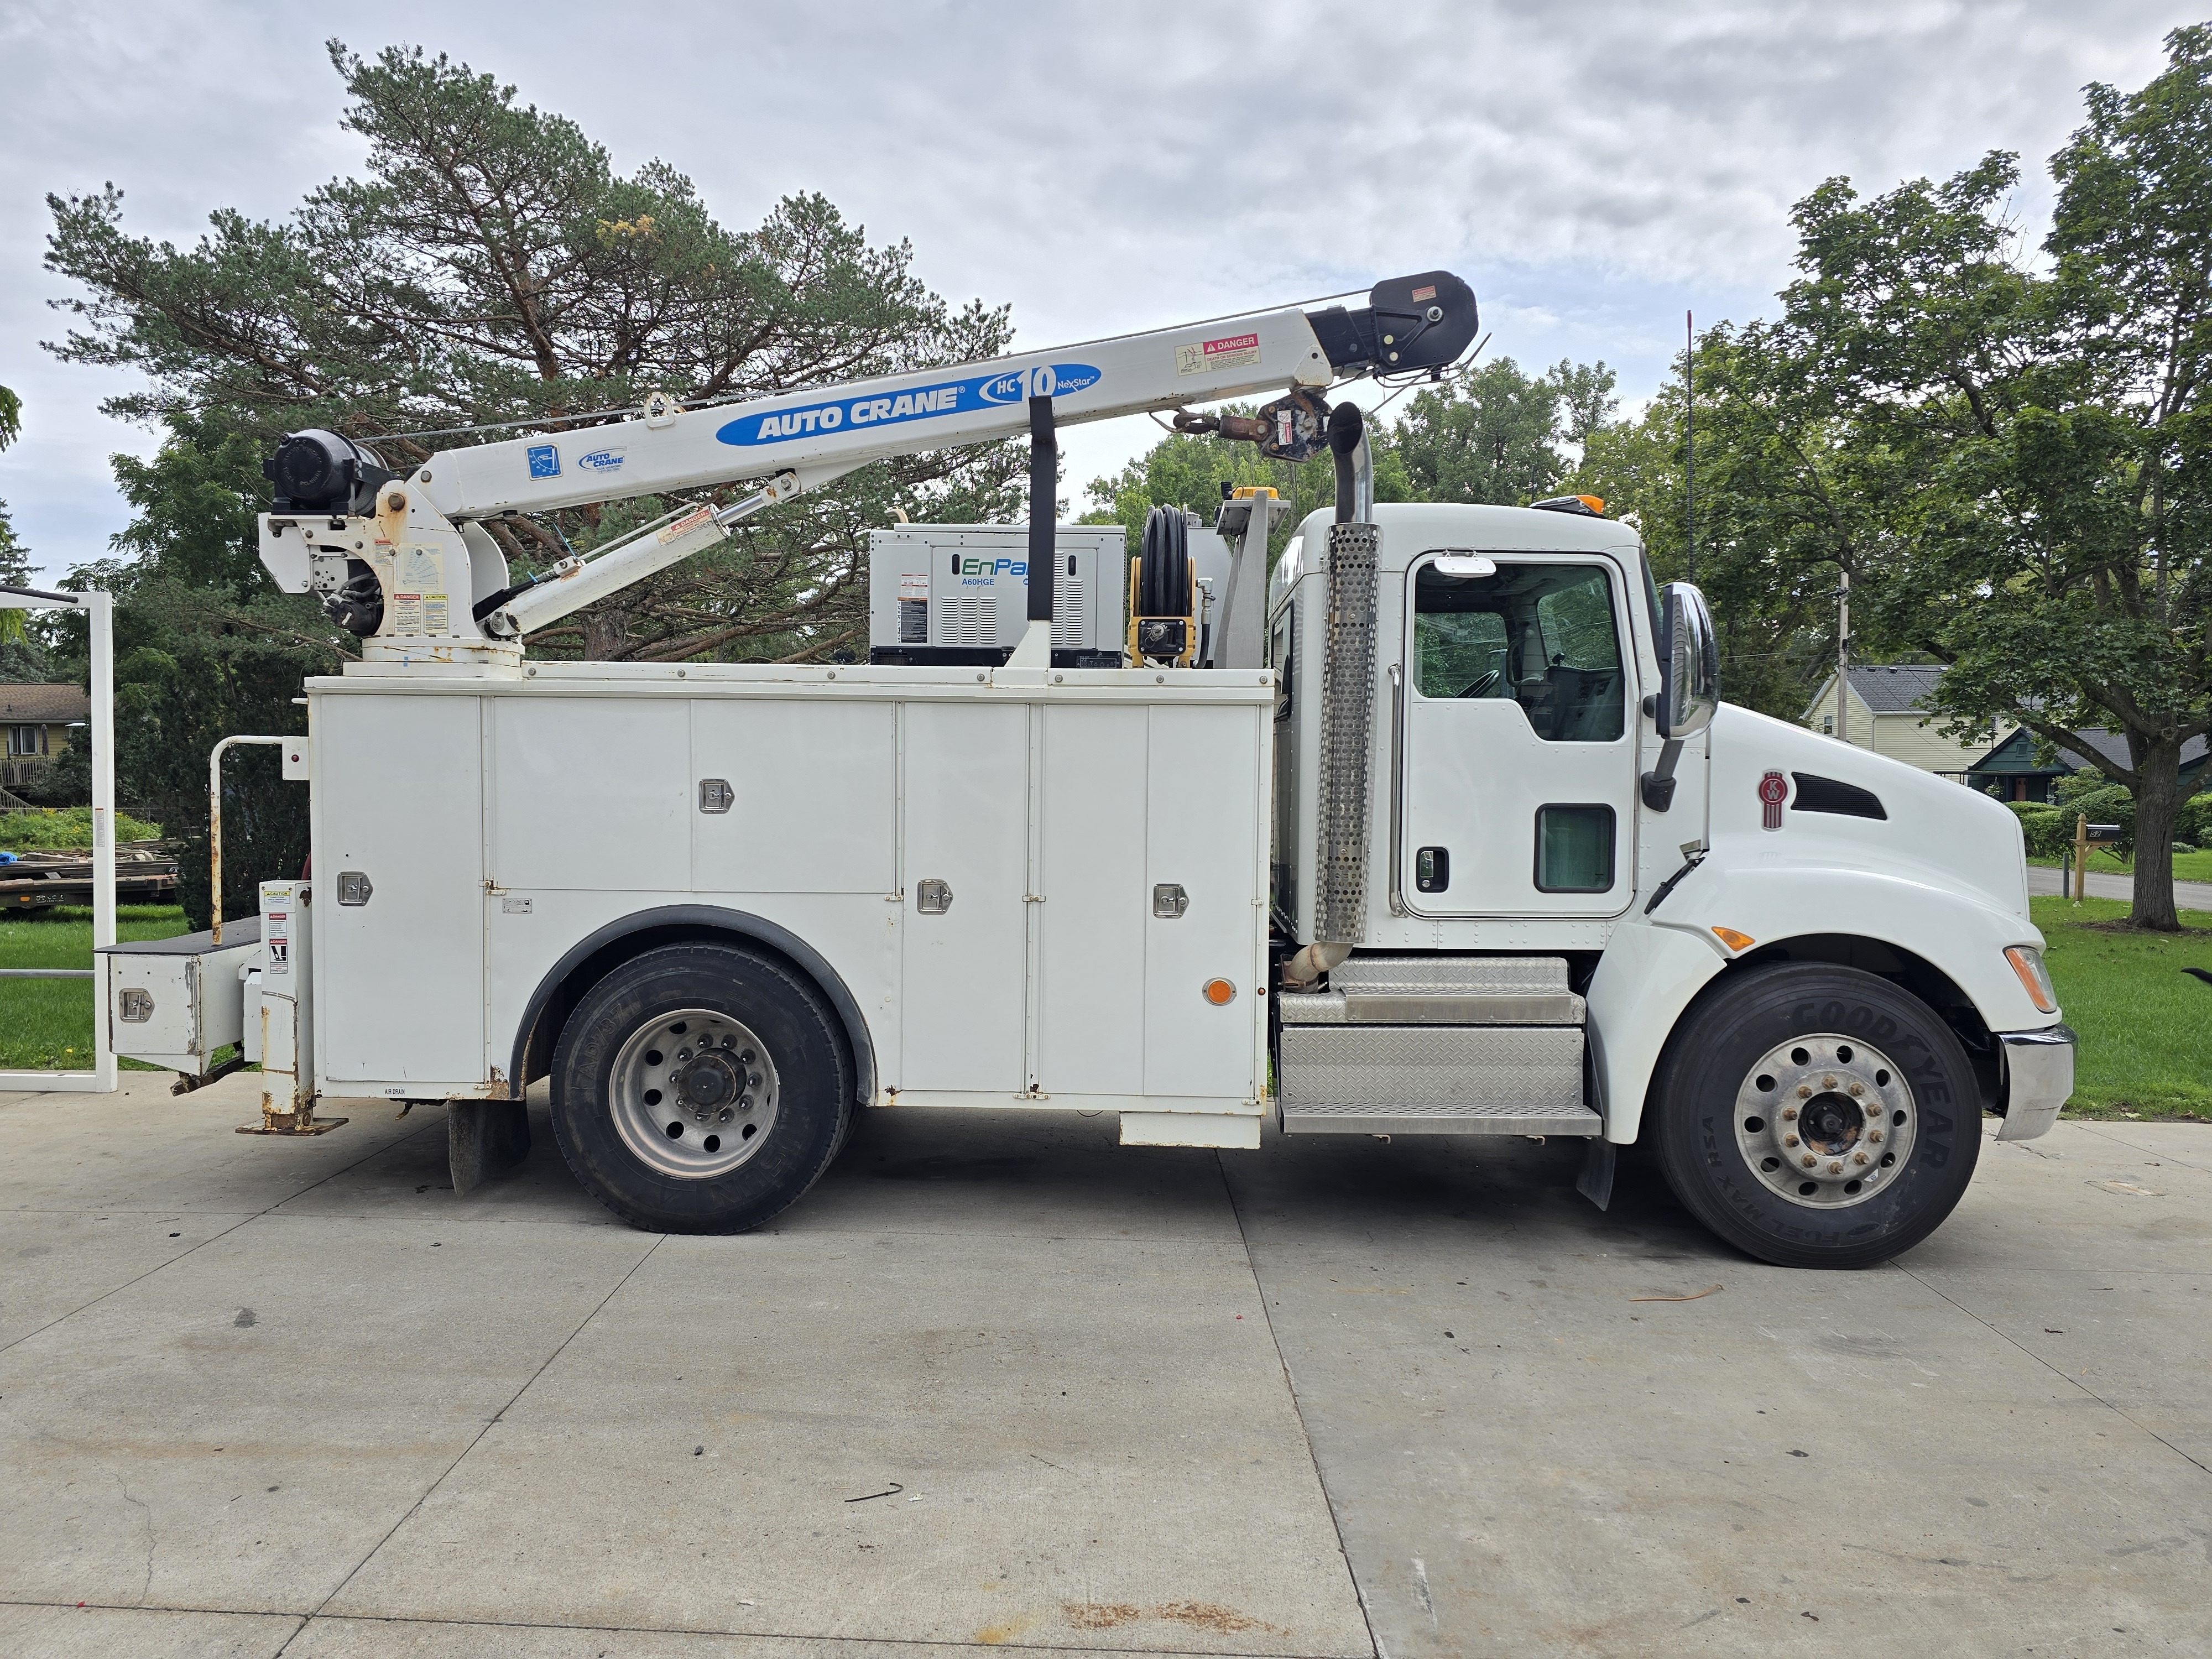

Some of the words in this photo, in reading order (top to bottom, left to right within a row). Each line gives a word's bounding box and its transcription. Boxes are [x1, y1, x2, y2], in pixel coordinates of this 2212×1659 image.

[1218, 337, 1255, 349] DANGER
[997, 379, 1015, 394] HC
[757, 406, 842, 440] AUTO
[586, 453, 610, 462] AUTO
[593, 457, 624, 467] CRANE
[681, 512, 706, 526] DANGER
[962, 559, 1029, 575] EnPa
[1770, 781, 1778, 790] K
[1766, 790, 1780, 800] W
[578, 1003, 625, 1079] AD737
[1702, 1115, 1723, 1168] RSA
[1717, 1174, 1765, 1217] MAX
[1771, 1218, 1840, 1243] FUEL
